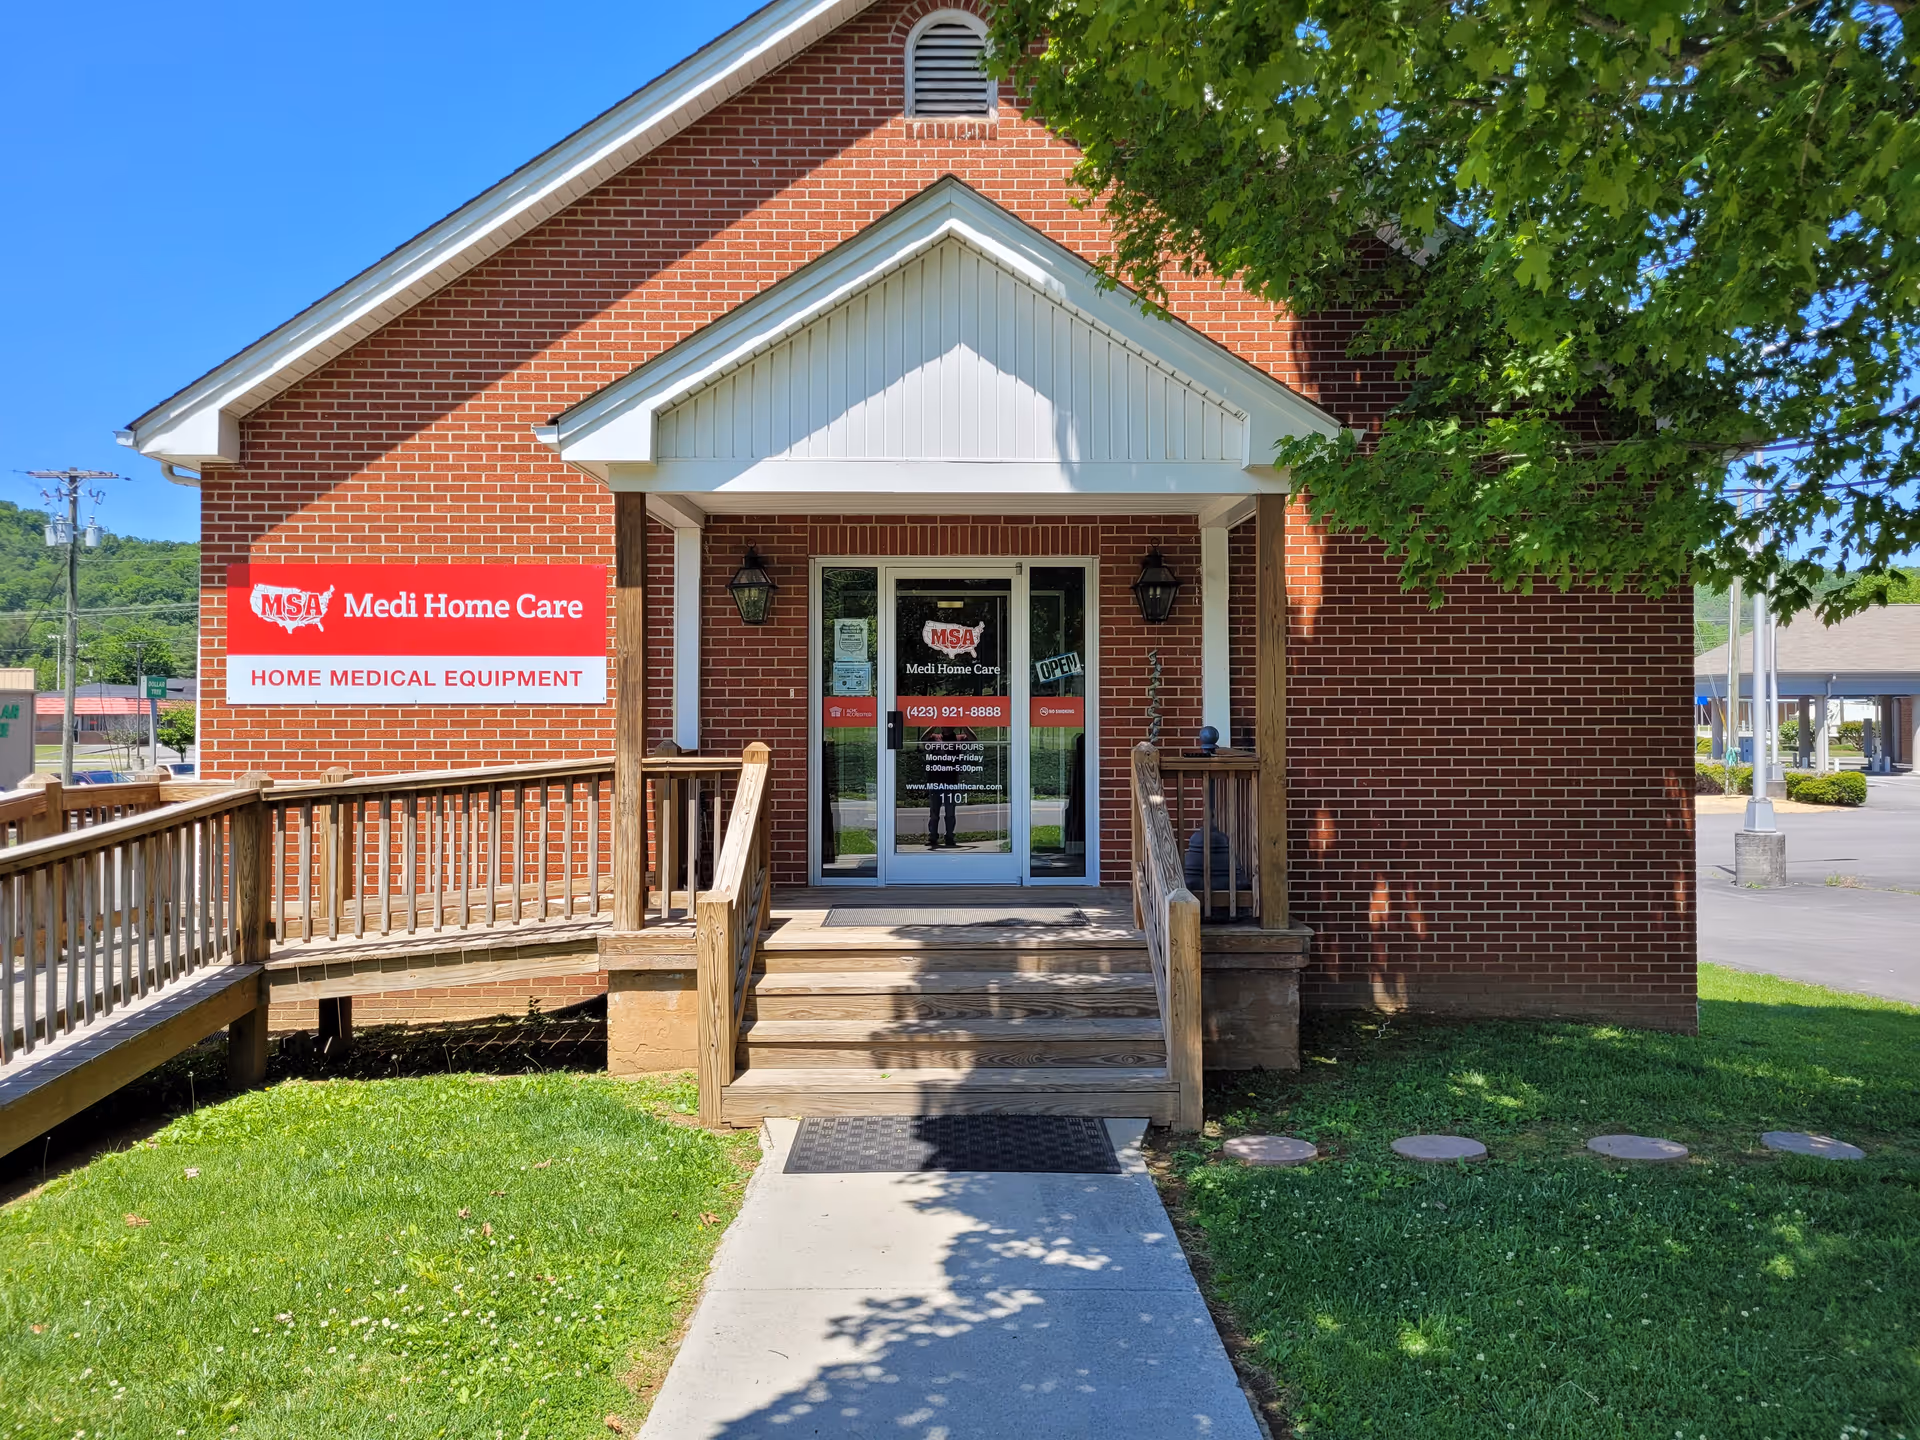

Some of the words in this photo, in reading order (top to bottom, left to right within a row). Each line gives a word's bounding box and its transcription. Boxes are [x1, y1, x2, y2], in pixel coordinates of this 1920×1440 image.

[260, 593, 323, 620] MSA
[344, 591, 418, 618] Medi
[424, 593, 510, 618] Home
[516, 593, 583, 618] Care
[931, 628, 975, 648] MSA
[906, 663, 935, 674] Medi
[937, 663, 972, 674] Home
[974, 664, 1000, 674] Care
[1040, 654, 1078, 679] OPEN
[251, 670, 321, 686] HOME
[330, 670, 436, 686] MEDICAL
[444, 670, 583, 687] EQUIPMENT
[906, 706, 938, 719] (423)
[941, 706, 1001, 717] 921-8888
[924, 743, 954, 751] OFFICE
[955, 743, 984, 751] HOURS
[925, 753, 983, 762] Monday-Friday
[925, 764, 983, 773] 8:00am-5:00pm
[906, 782, 1003, 790] www.MSAhealthcare.com
[940, 793, 968, 804] 1101
